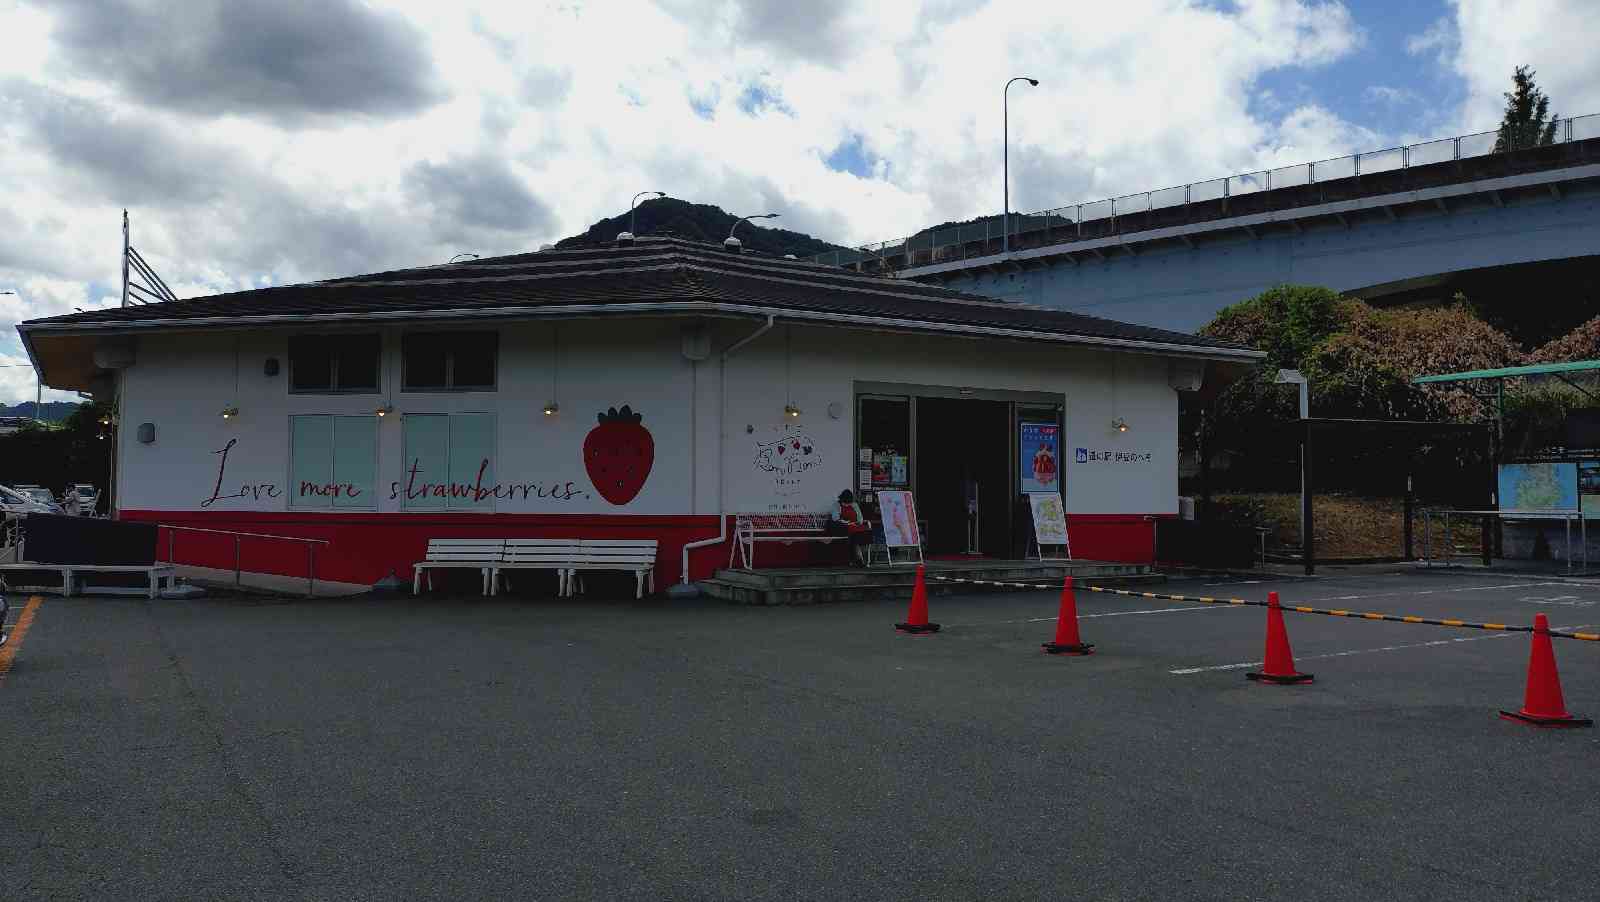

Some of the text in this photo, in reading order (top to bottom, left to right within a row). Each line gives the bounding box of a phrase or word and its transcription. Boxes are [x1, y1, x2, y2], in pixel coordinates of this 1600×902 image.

[201, 438, 590, 508] Love more strawberries.
